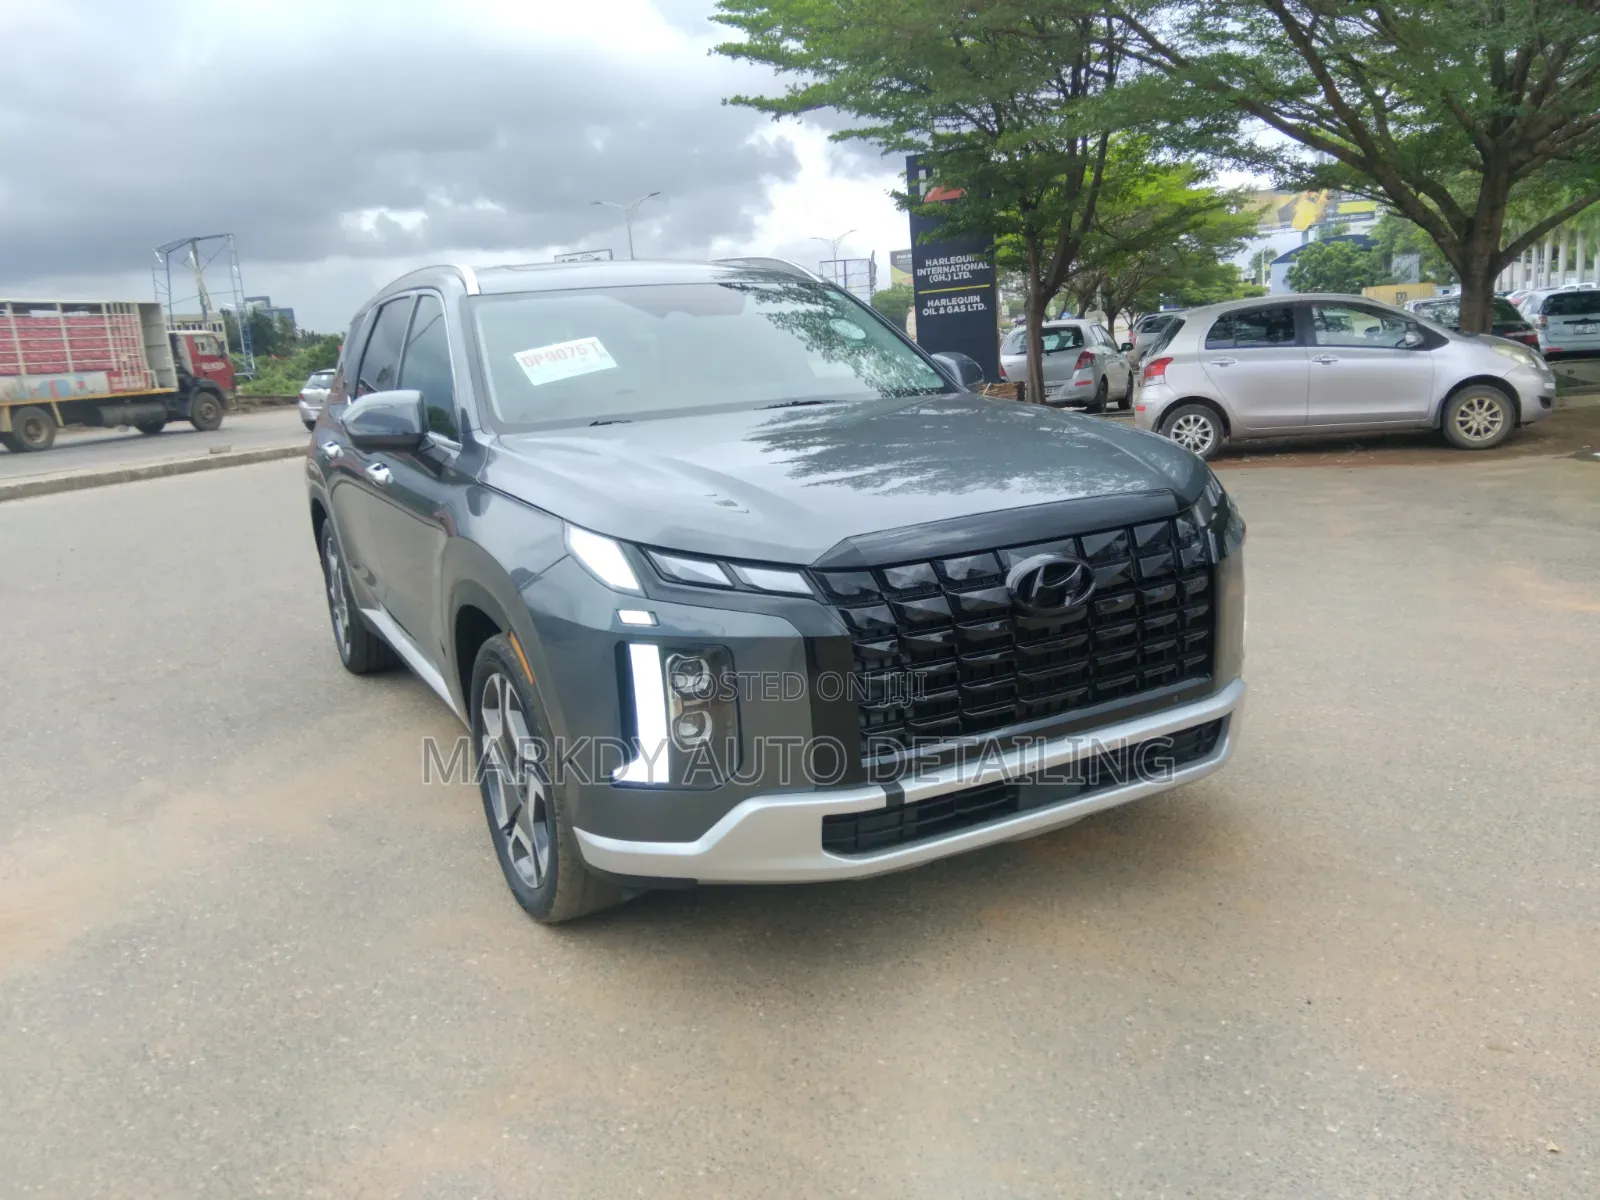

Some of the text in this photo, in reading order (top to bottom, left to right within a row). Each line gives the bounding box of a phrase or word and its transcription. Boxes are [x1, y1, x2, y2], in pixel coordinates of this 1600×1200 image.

[917, 262, 990, 276] INTERNATIONAL
[929, 271, 972, 283] (GH.) LTD.
[927, 295, 980, 307] HARLEQUIN
[922, 308, 937, 316] OIL
[946, 305, 966, 313] GAS
[968, 303, 987, 311] LTD.
